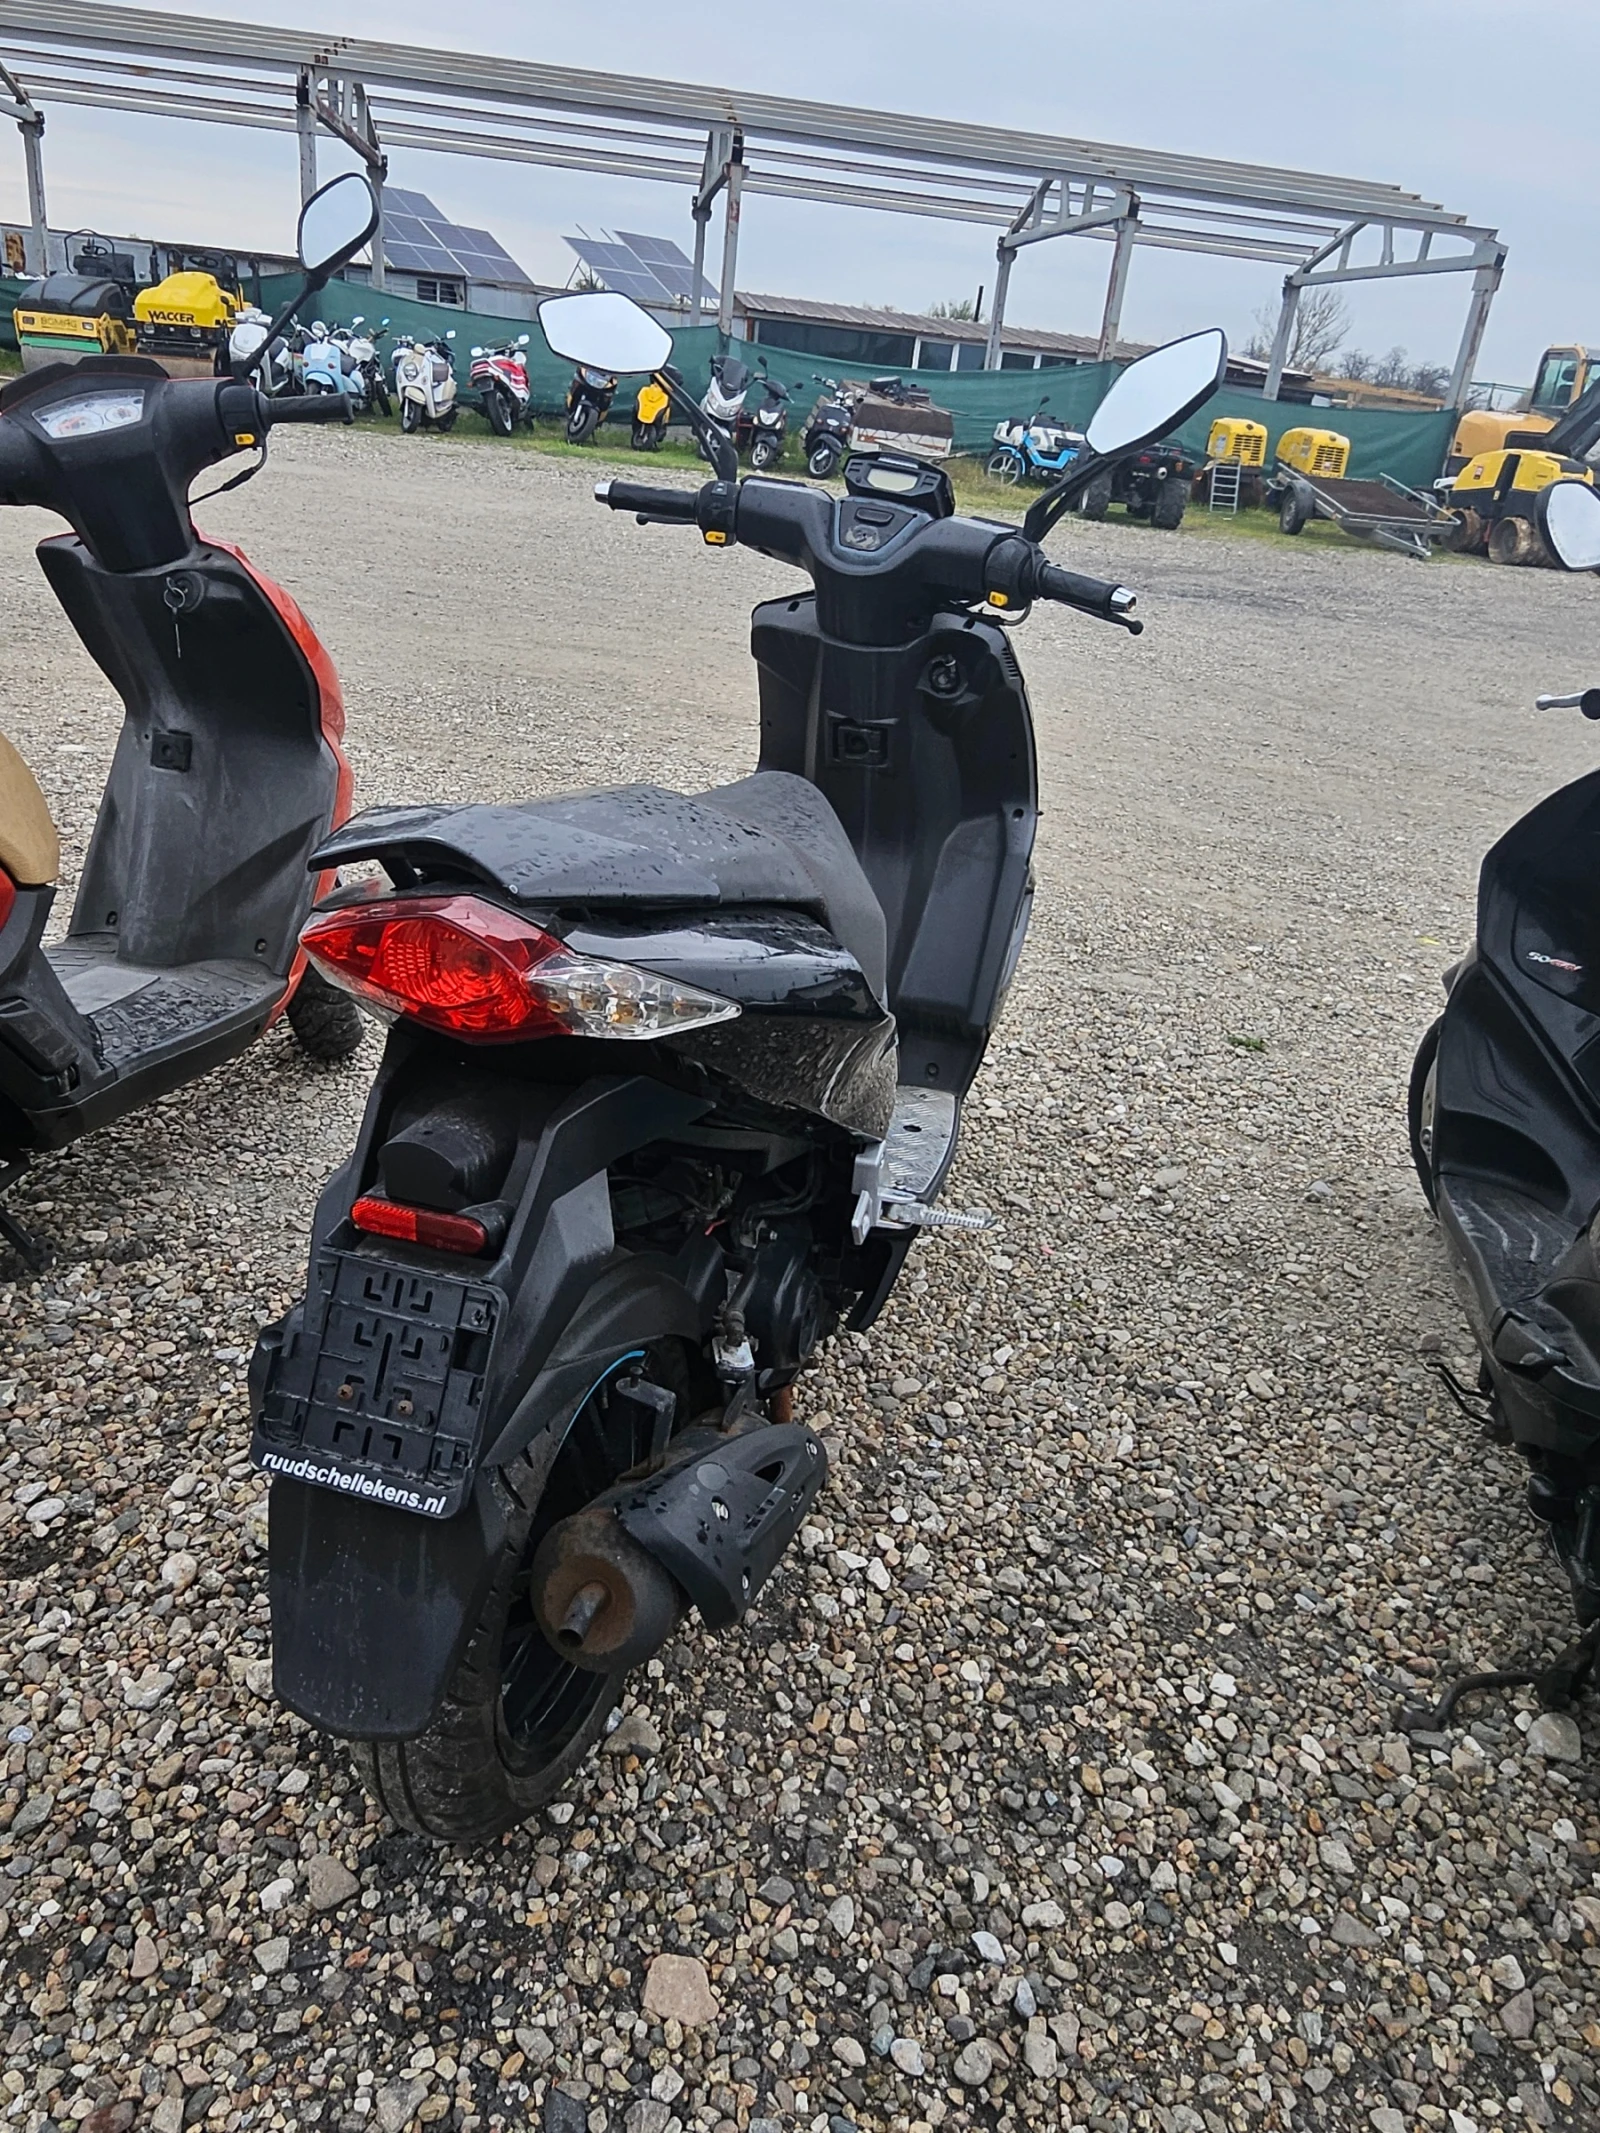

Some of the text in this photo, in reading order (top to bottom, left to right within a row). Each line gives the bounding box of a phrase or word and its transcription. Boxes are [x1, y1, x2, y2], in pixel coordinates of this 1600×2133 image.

[40, 316, 78, 328] BOMAG
[147, 310, 196, 324] WACKER
[261, 1452, 447, 1515] ruudschellekens.nl
